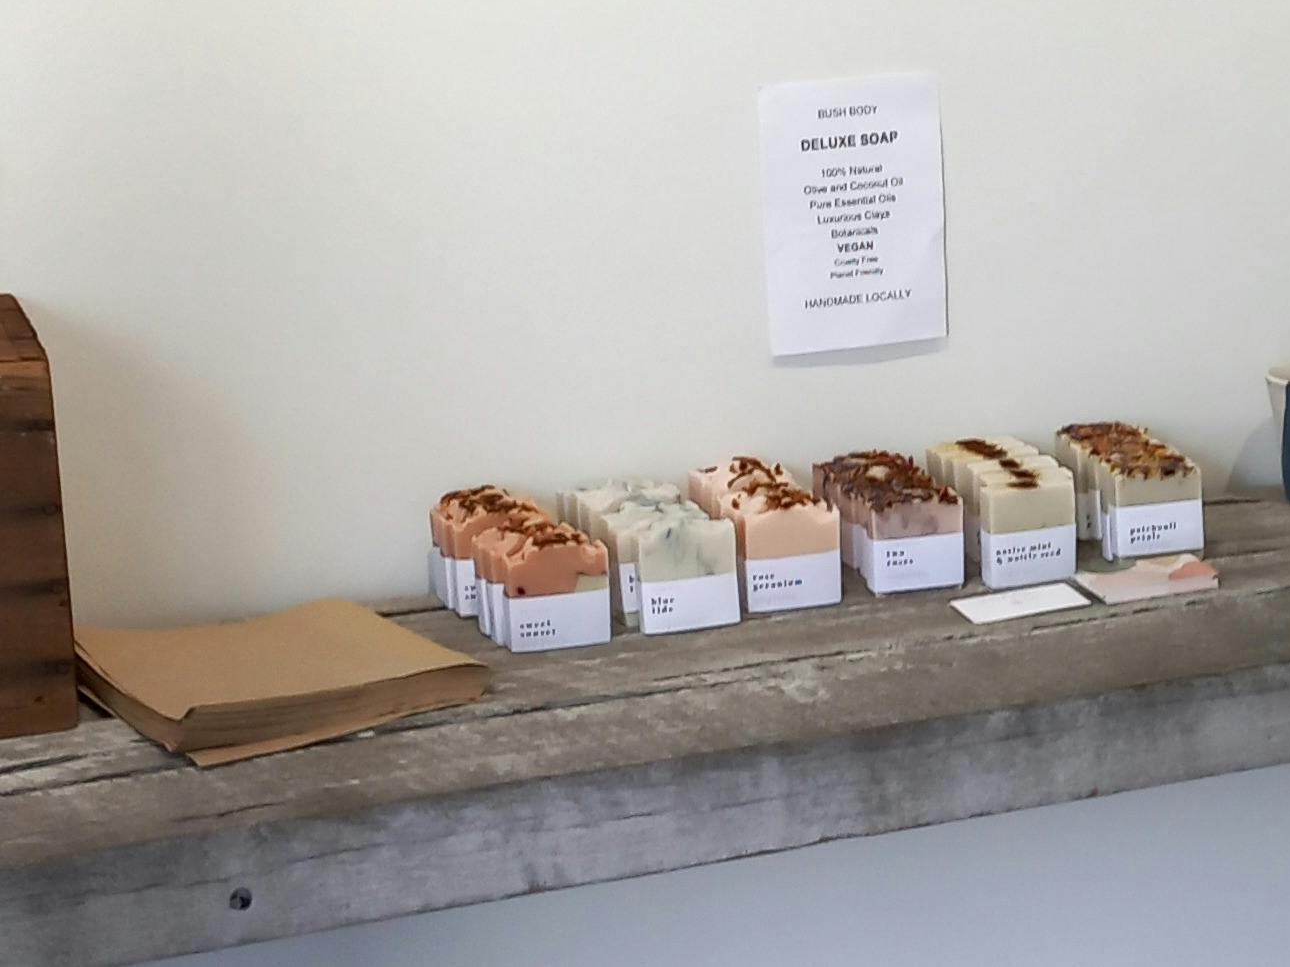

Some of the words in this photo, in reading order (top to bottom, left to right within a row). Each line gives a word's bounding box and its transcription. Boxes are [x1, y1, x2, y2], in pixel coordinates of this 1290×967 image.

[817, 107, 847, 119] BUSH
[849, 105, 878, 117] BODY
[800, 134, 857, 152] DELUXE
[860, 130, 898, 146] SOAP
[821, 167, 847, 178] 100%
[849, 164, 883, 176] Natural
[803, 185, 828, 195] Olive
[830, 182, 848, 193] and
[849, 178, 888, 191] Coconut
[890, 177, 904, 187] Oil
[809, 200, 832, 210] Pure
[834, 195, 877, 208] Essential
[878, 193, 897, 204] Oils
[817, 213, 862, 225] Luxurious
[864, 210, 891, 221] Clays
[831, 226, 879, 239] Botanicals
[837, 241, 874, 253] VEGAN
[804, 293, 864, 310] HANDMADE
[865, 289, 912, 304] LOCALLY
